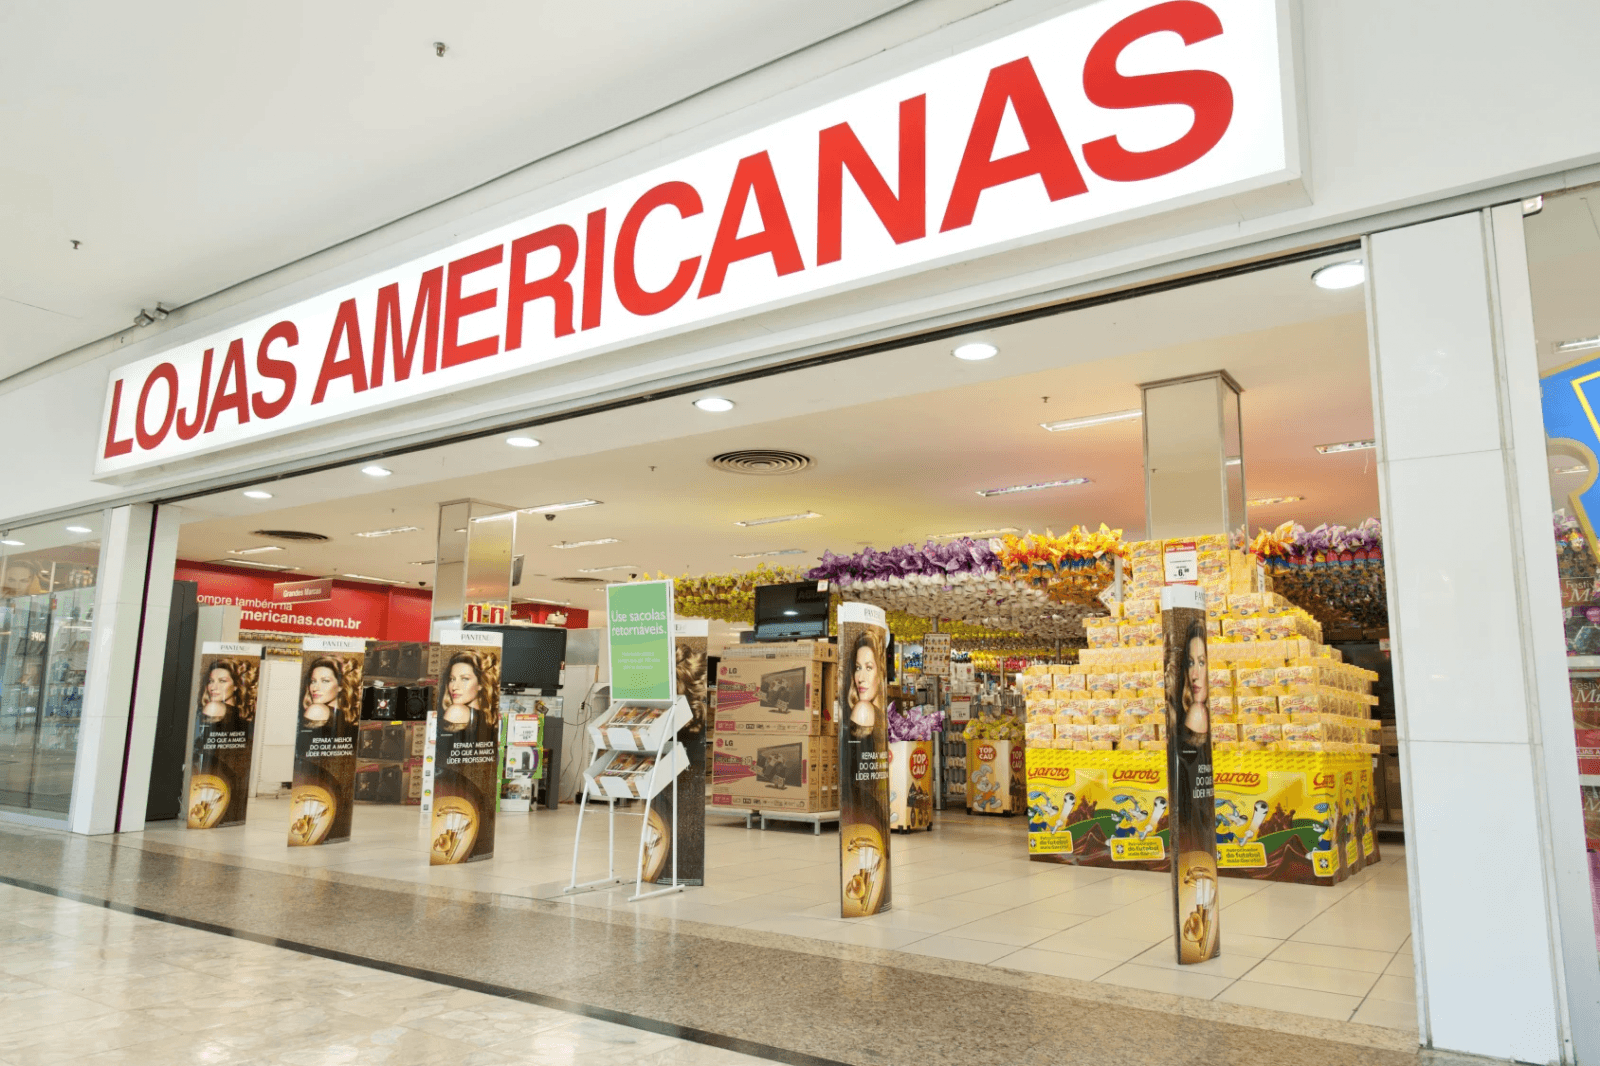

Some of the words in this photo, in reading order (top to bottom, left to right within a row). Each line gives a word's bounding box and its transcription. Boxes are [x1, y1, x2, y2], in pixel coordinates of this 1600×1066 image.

[105, 321, 298, 457] LOJAS
[312, 0, 1233, 404] AMERICANAS
[283, 588, 304, 598] Grandes
[305, 588, 322, 596] Marcas
[197, 595, 233, 608] ompre
[240, 609, 362, 629] mericanas.com.br
[611, 610, 628, 622] Use
[629, 608, 667, 622] sacolas
[612, 622, 667, 636] retornáveis.
[729, 667, 738, 675] LG
[450, 749, 461, 757] DO
[912, 753, 927, 764] TOP
[859, 762, 869, 770] DO
[912, 764, 926, 775] CAU
[855, 769, 870, 781] LÍDER
[1195, 776, 1204, 786] DO
